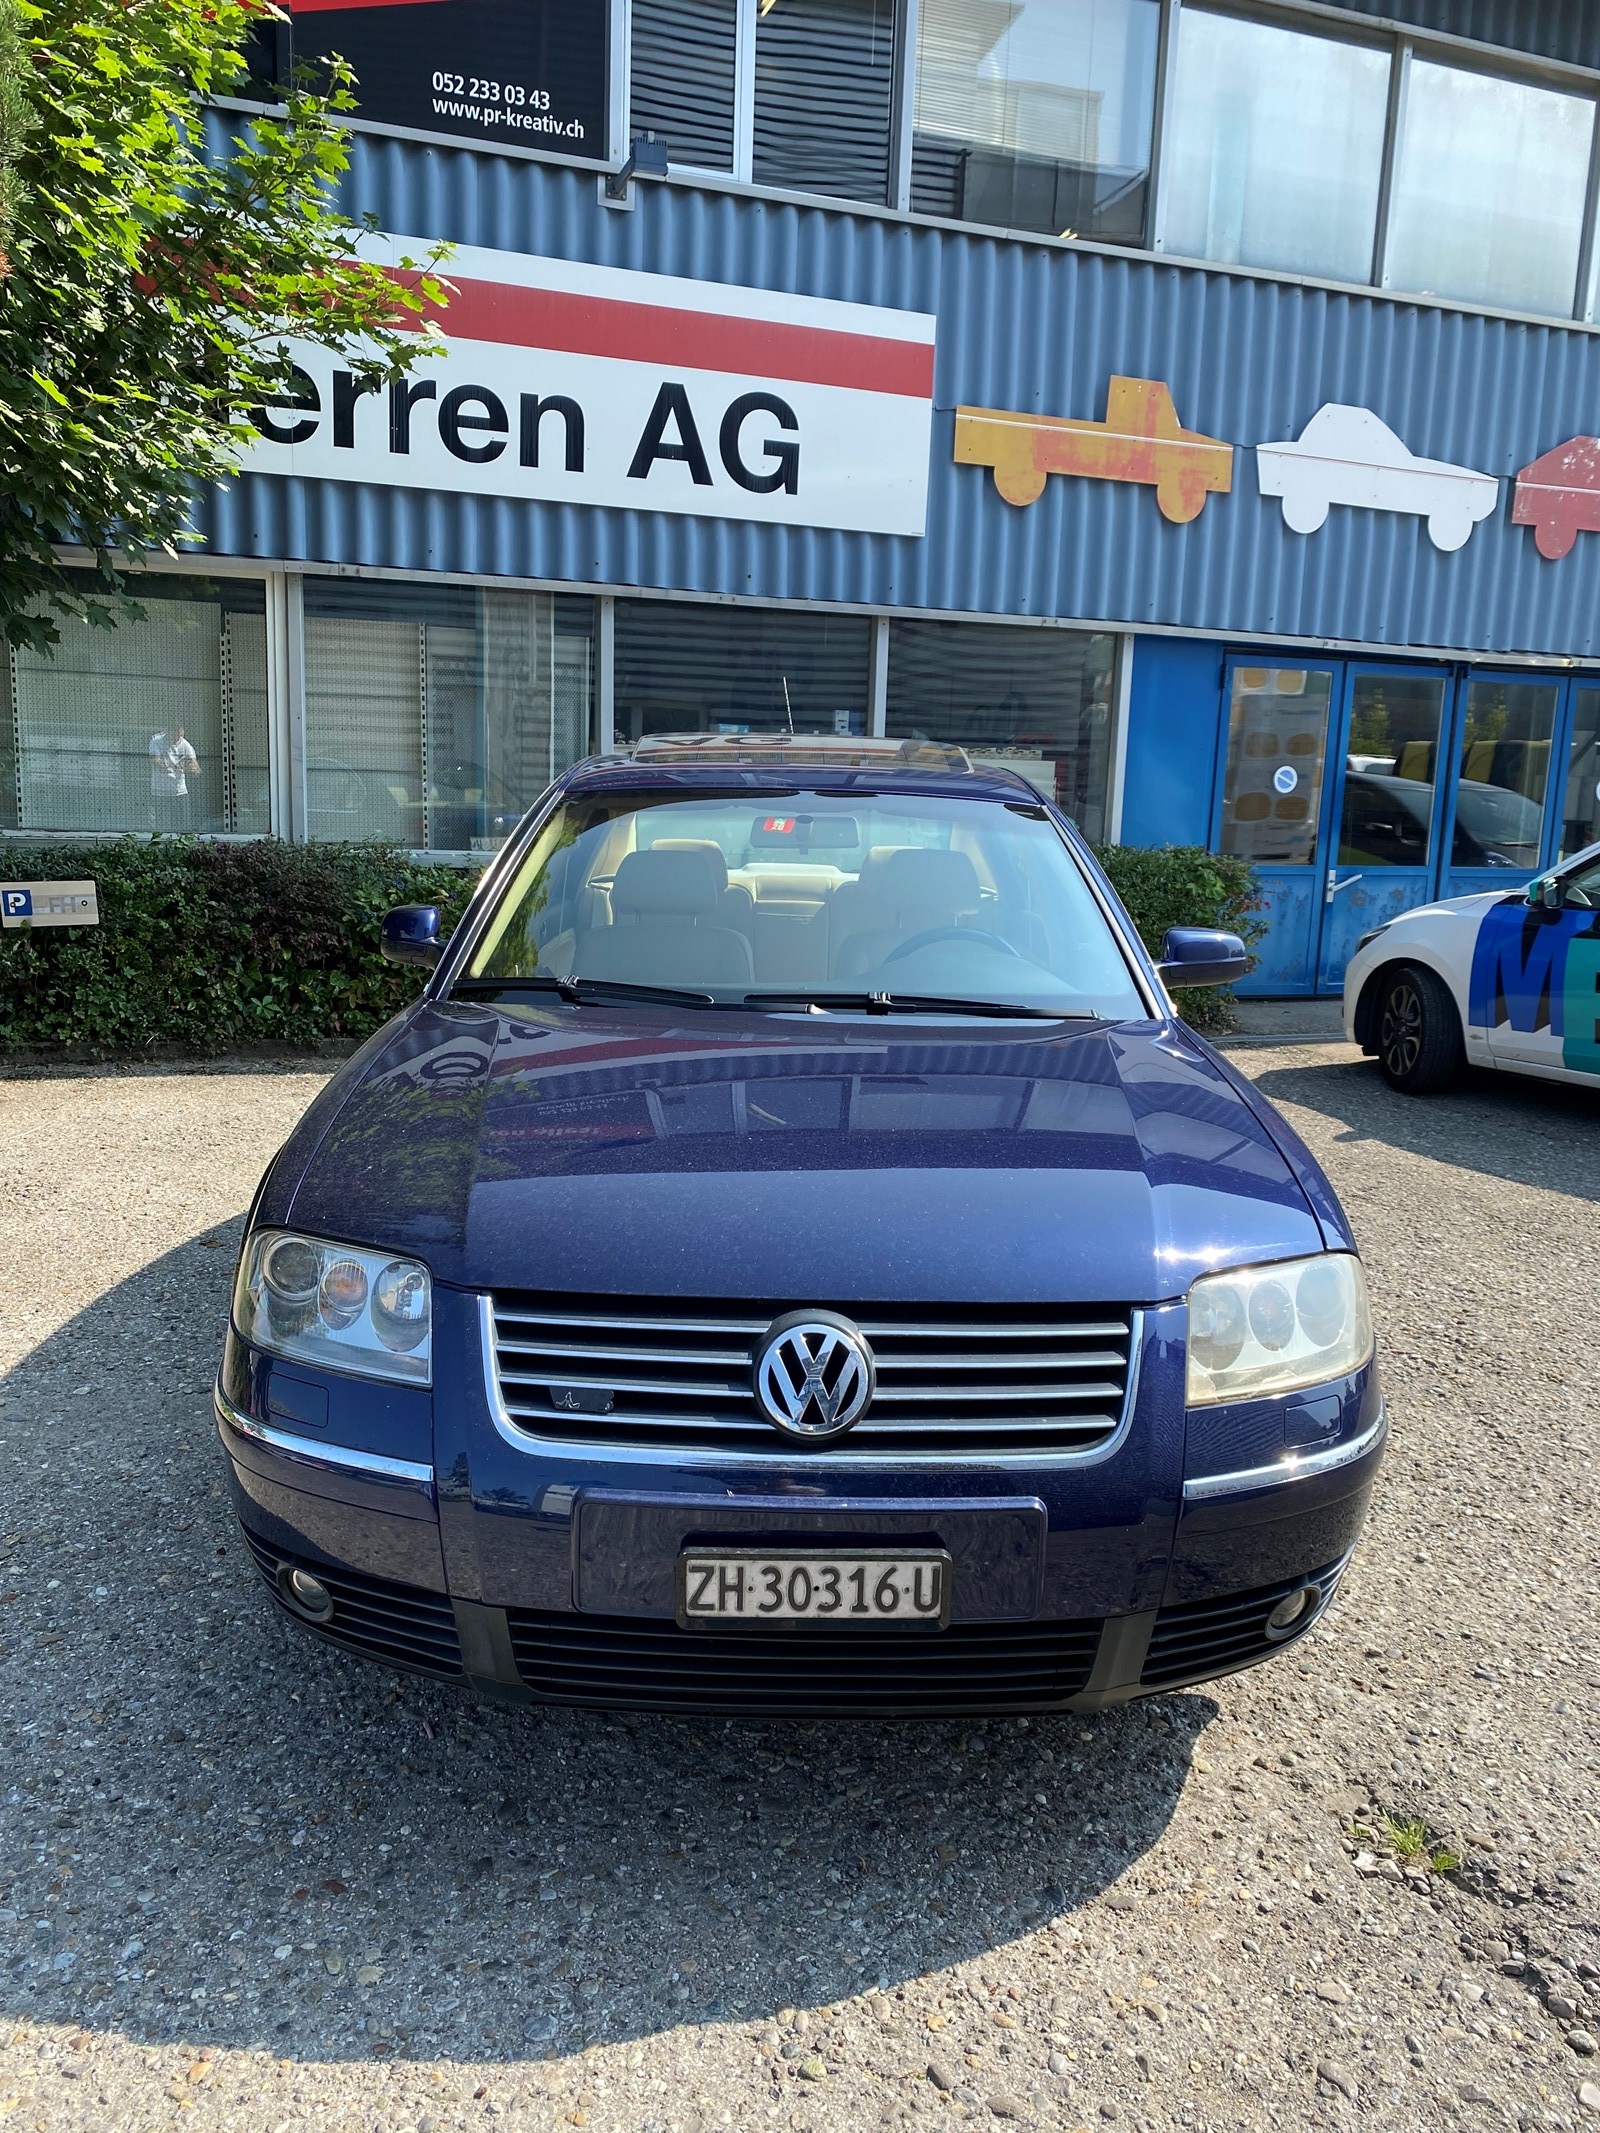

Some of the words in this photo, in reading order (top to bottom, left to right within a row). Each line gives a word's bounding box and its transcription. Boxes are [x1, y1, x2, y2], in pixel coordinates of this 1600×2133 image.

[432, 71, 465, 95] 052
[469, 78, 500, 101] 233
[504, 84, 526, 106] 03
[529, 89, 551, 111] 43
[432, 98, 585, 139] www.pr-kreativ.ch
[216, 352, 585, 473] erren
[627, 381, 801, 496] AG
[7, 892, 27, 914] P
[759, 1323, 869, 1435] VW
